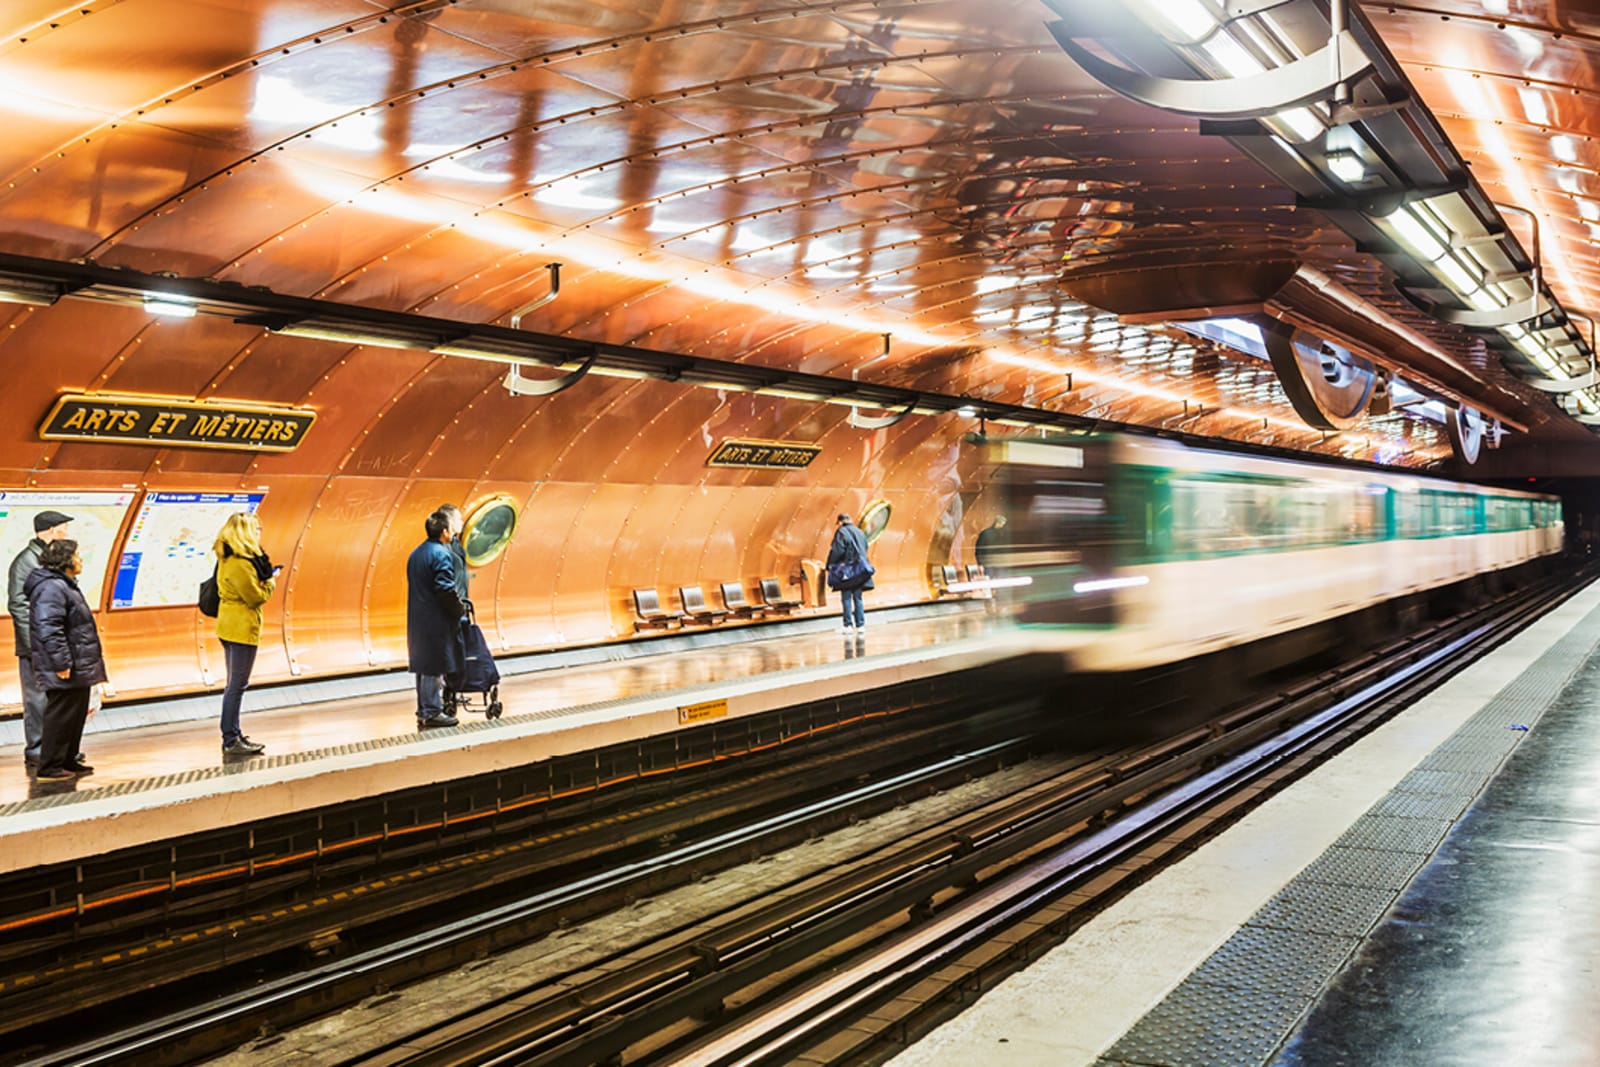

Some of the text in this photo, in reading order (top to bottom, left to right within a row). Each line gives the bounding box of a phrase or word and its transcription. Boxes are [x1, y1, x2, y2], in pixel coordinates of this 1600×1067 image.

[62, 408, 299, 441] ARTS ET MÉTIERS
[718, 447, 752, 462] ARTS
[751, 449, 770, 463] ET
